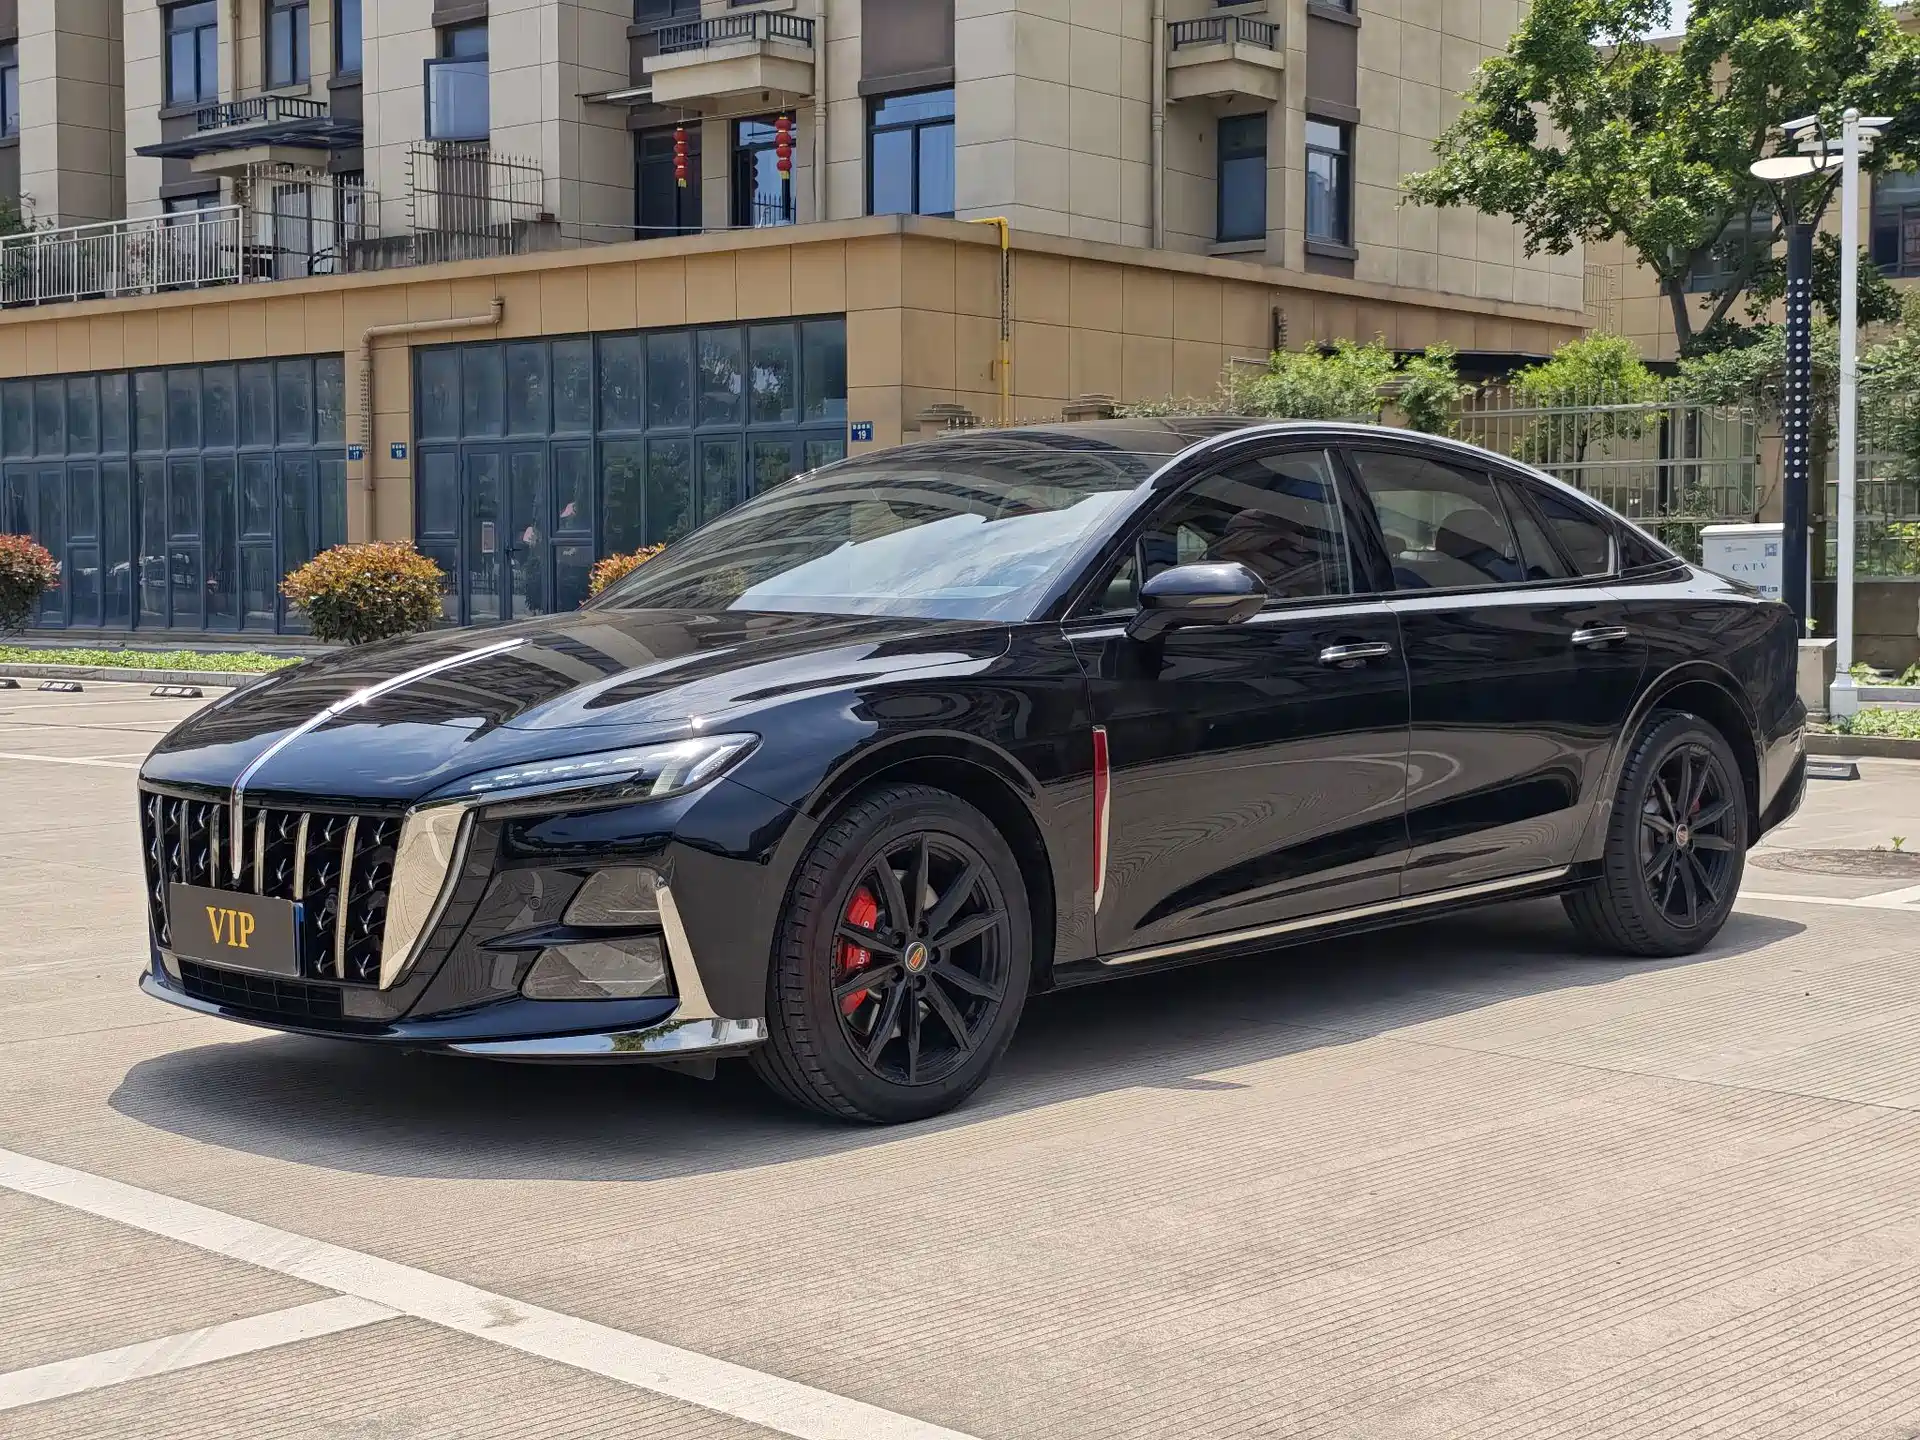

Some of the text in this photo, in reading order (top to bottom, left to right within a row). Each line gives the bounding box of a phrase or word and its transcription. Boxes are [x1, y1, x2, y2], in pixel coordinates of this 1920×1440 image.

[858, 430, 867, 440] 19
[1731, 562, 1768, 572] CATV
[205, 906, 256, 949] VIP
